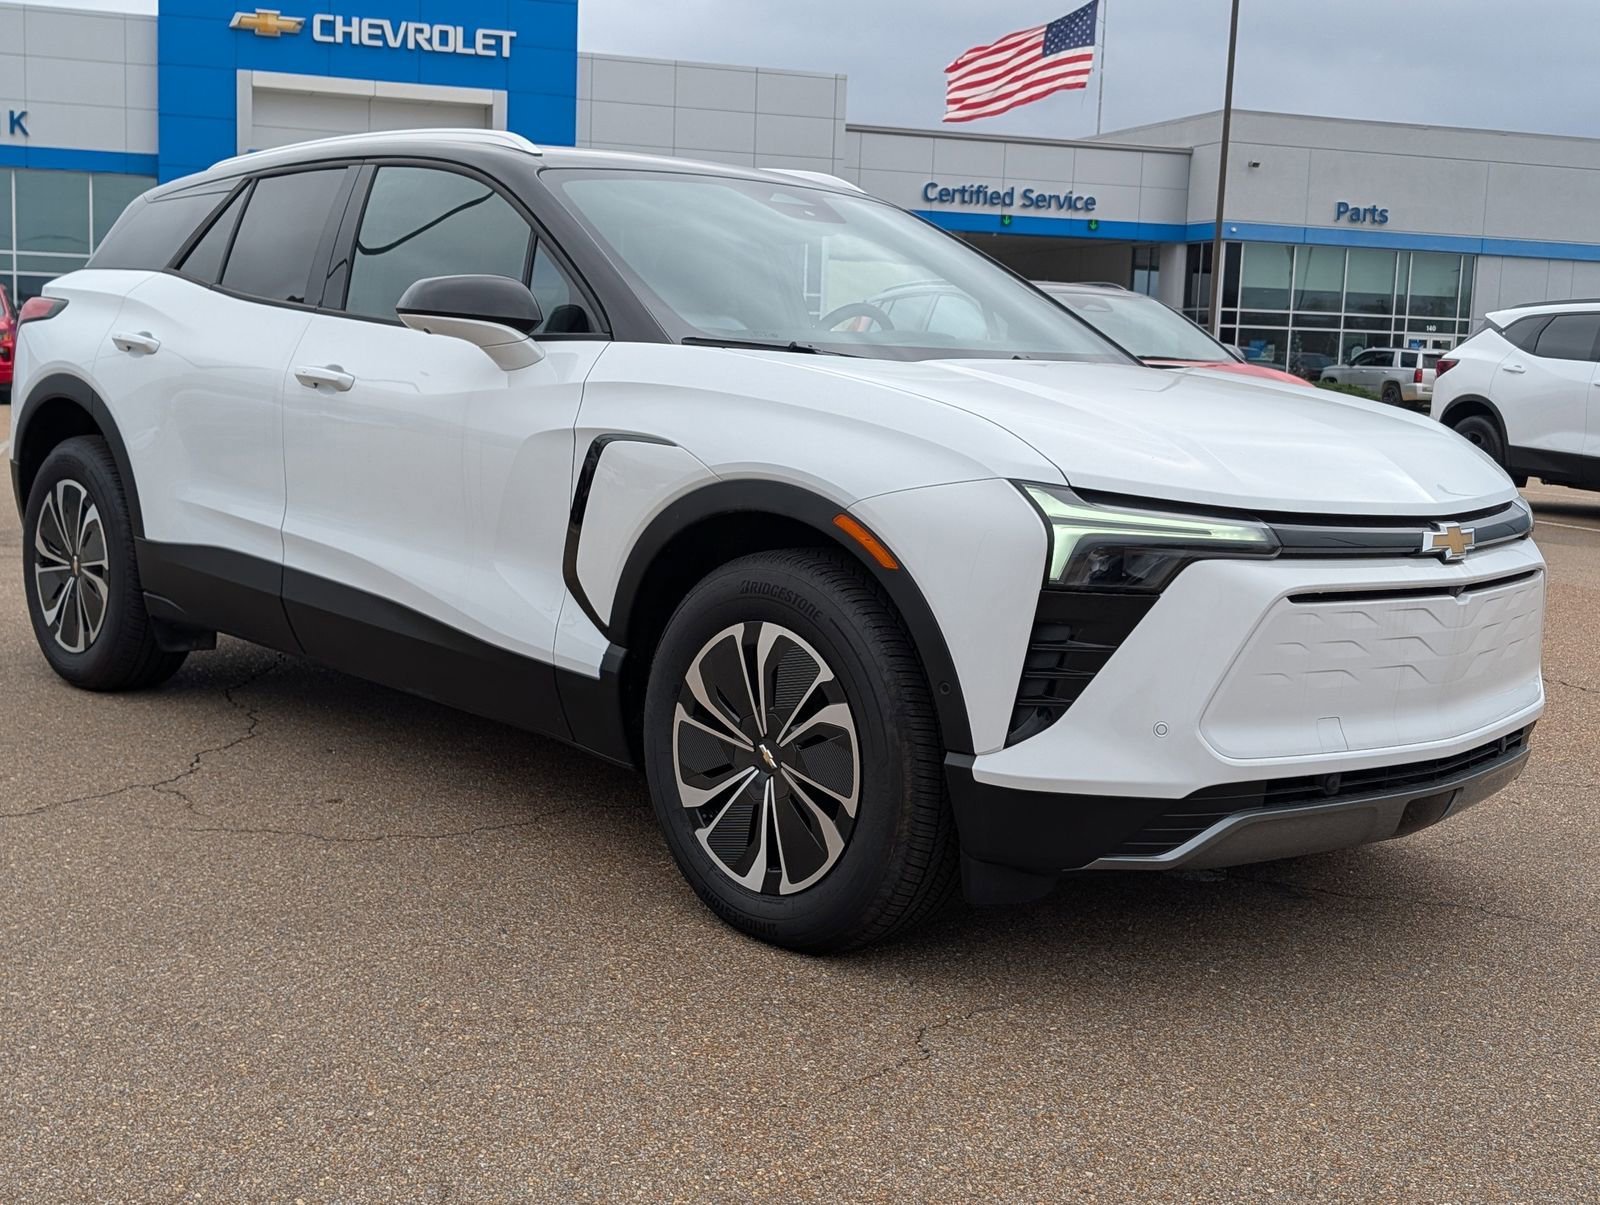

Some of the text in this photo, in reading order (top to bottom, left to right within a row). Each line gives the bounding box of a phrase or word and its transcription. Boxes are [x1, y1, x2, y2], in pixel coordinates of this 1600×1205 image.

[312, 13, 517, 58] CHEVROLET
[9, 109, 29, 136] K
[923, 182, 1097, 212] Certified Service
[1335, 201, 1389, 225] Parts
[739, 580, 824, 621] BRIDGESTONE
